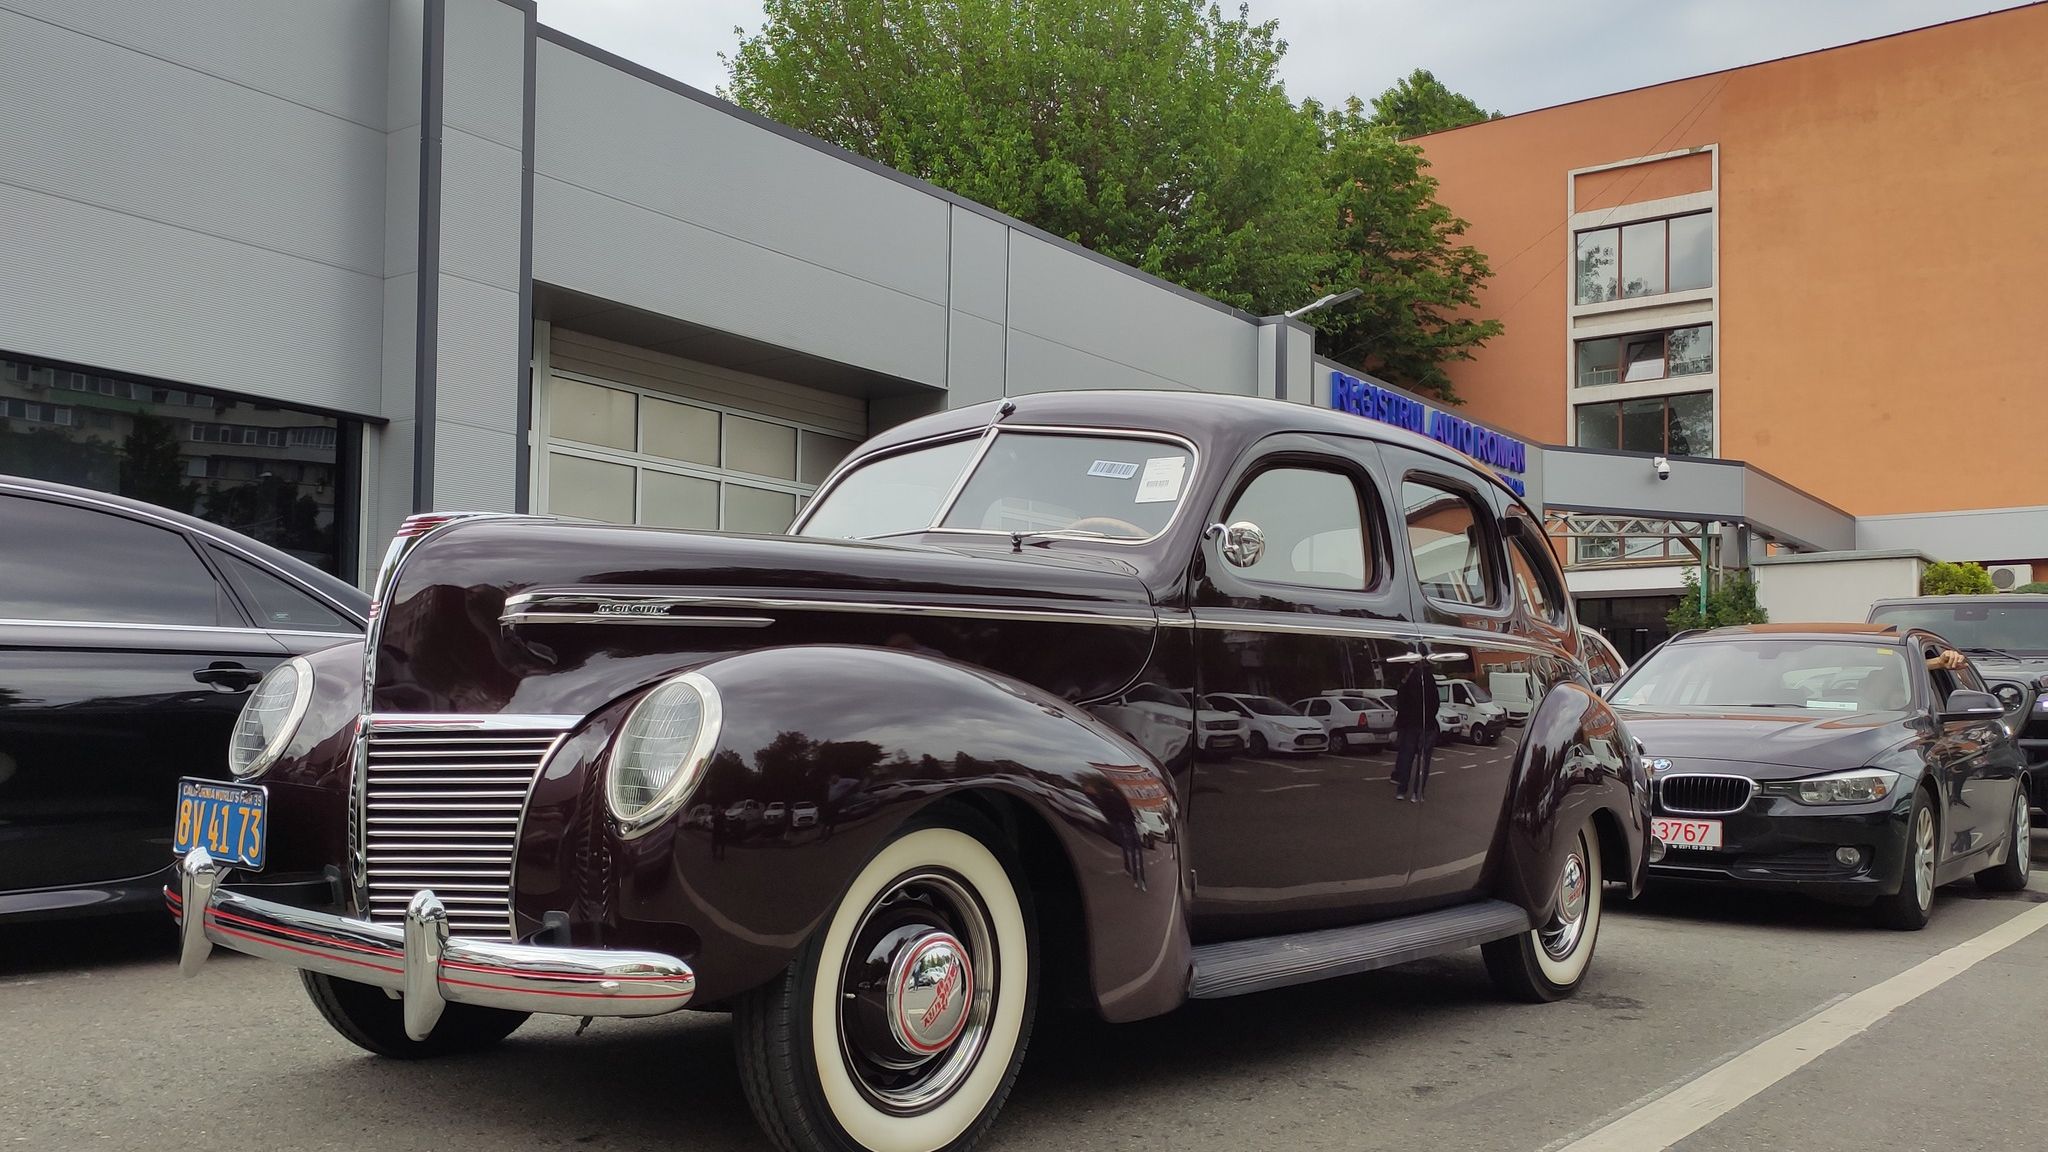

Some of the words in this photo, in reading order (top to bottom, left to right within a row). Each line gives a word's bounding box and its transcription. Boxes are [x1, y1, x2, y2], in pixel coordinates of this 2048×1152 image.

[1331, 371, 1425, 434] REGISTRUL
[1430, 410, 1473, 455] AUTO
[1474, 426, 1526, 474] ROMAN
[178, 799, 206, 849] 8V
[208, 803, 229, 853] 41
[238, 806, 262, 857] 73
